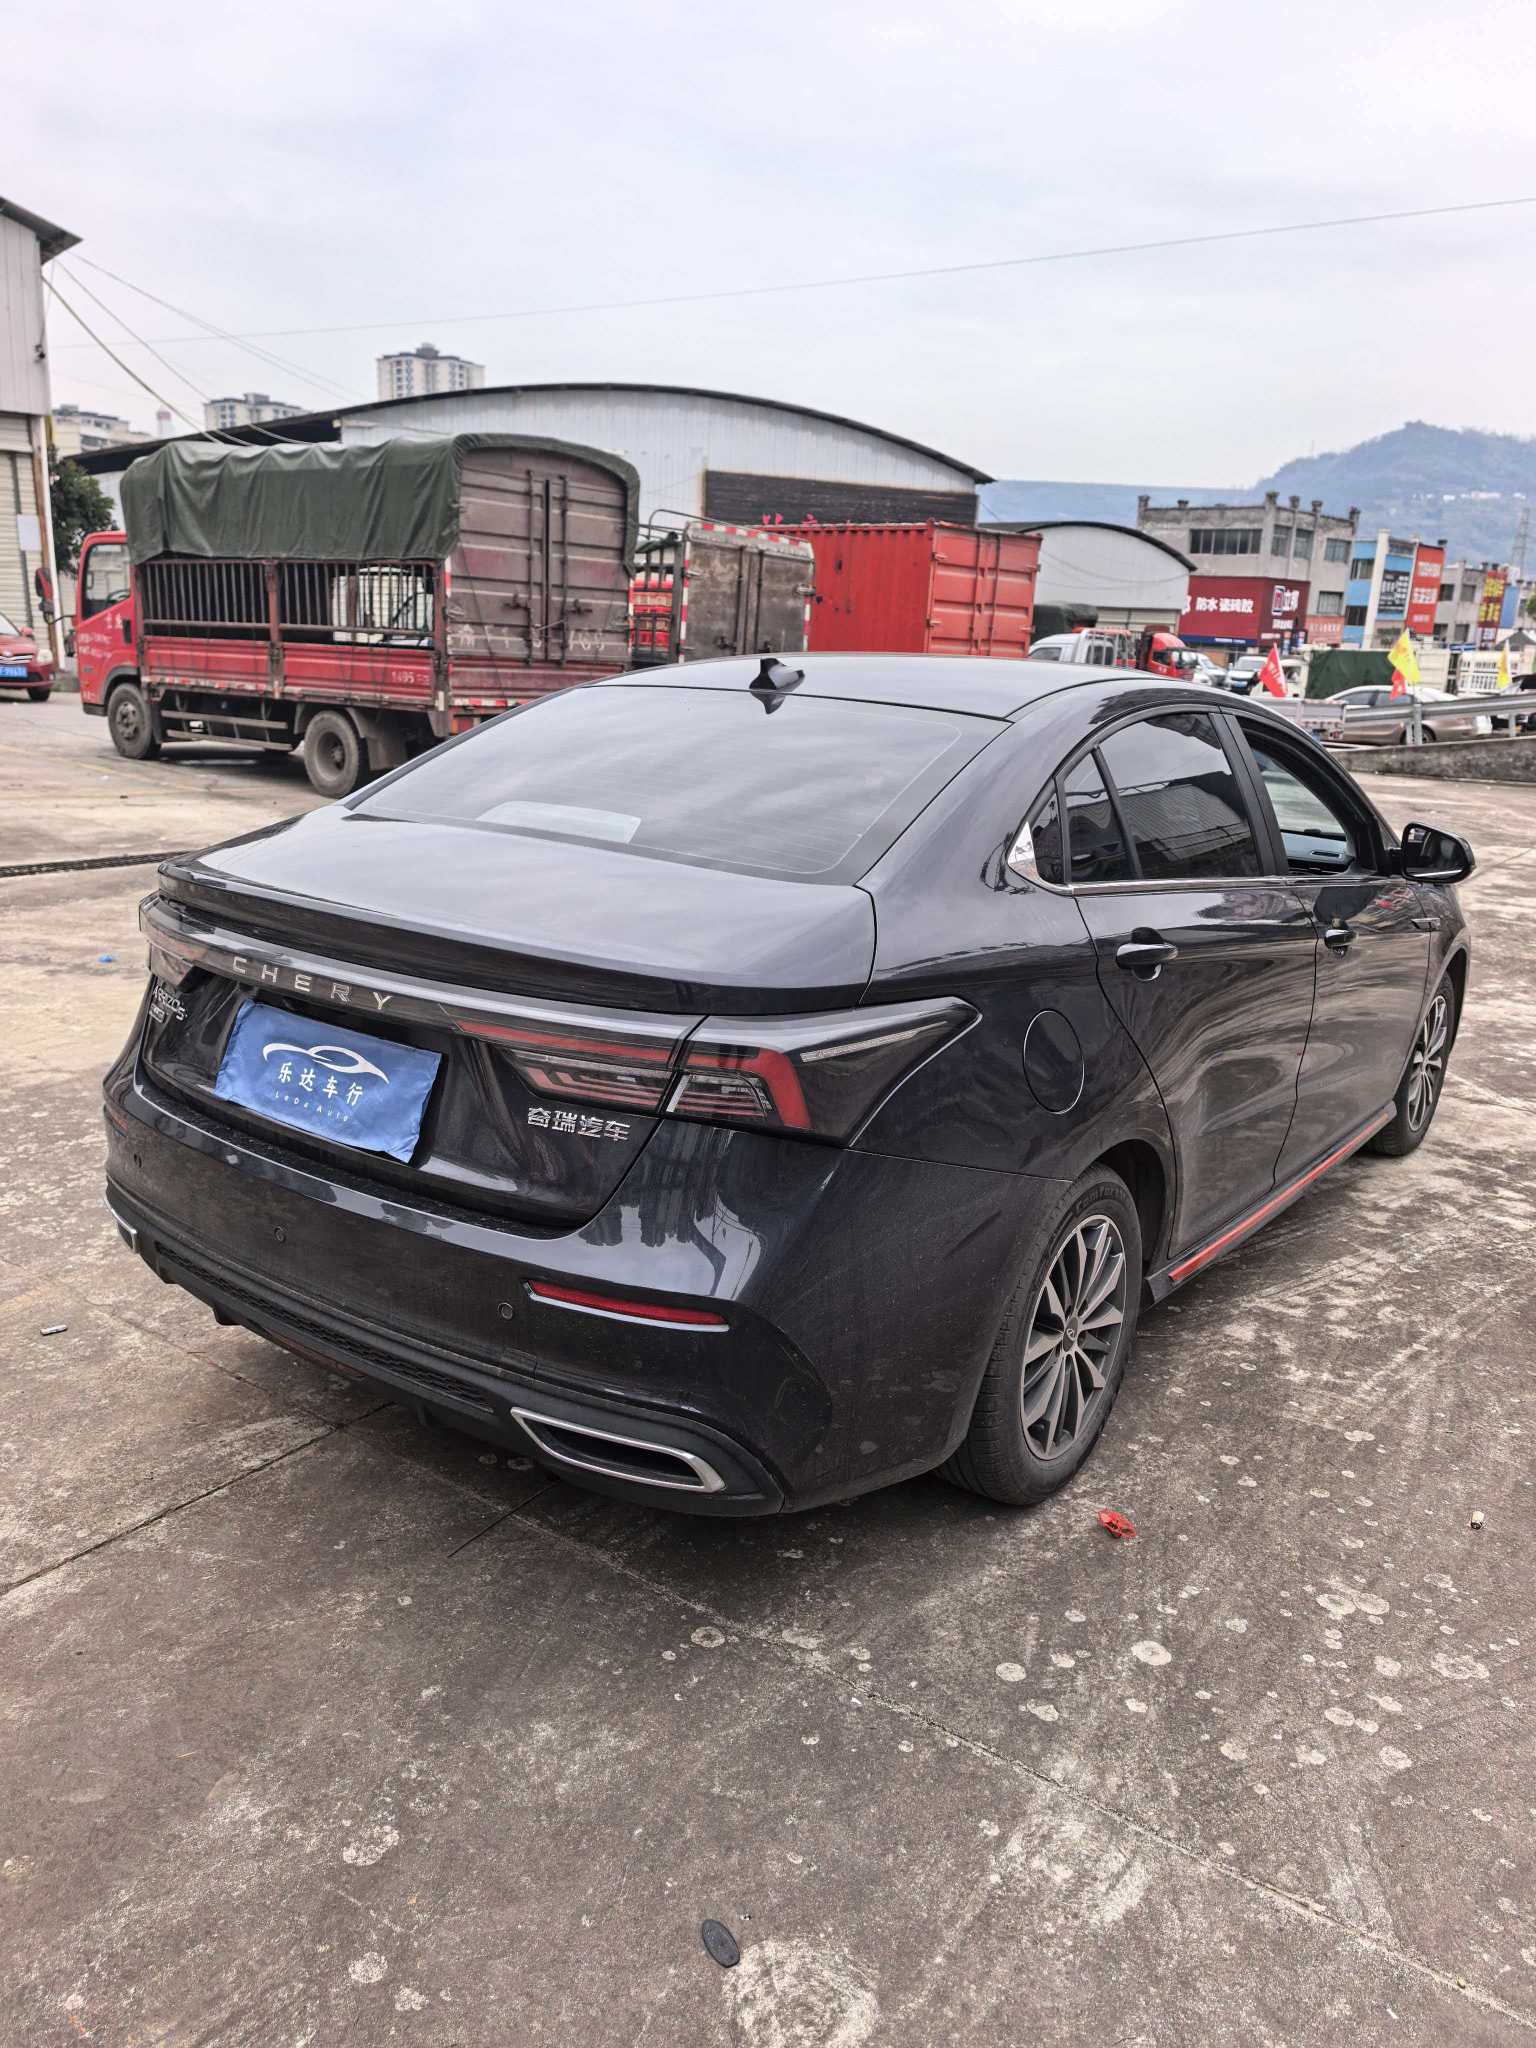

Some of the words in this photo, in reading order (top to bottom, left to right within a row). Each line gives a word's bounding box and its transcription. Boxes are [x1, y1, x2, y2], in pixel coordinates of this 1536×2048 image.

[232, 956, 392, 1010] CHERY
[278, 1061, 363, 1106] 乐达车行
[527, 1107, 631, 1141] 奇瑞汽车
